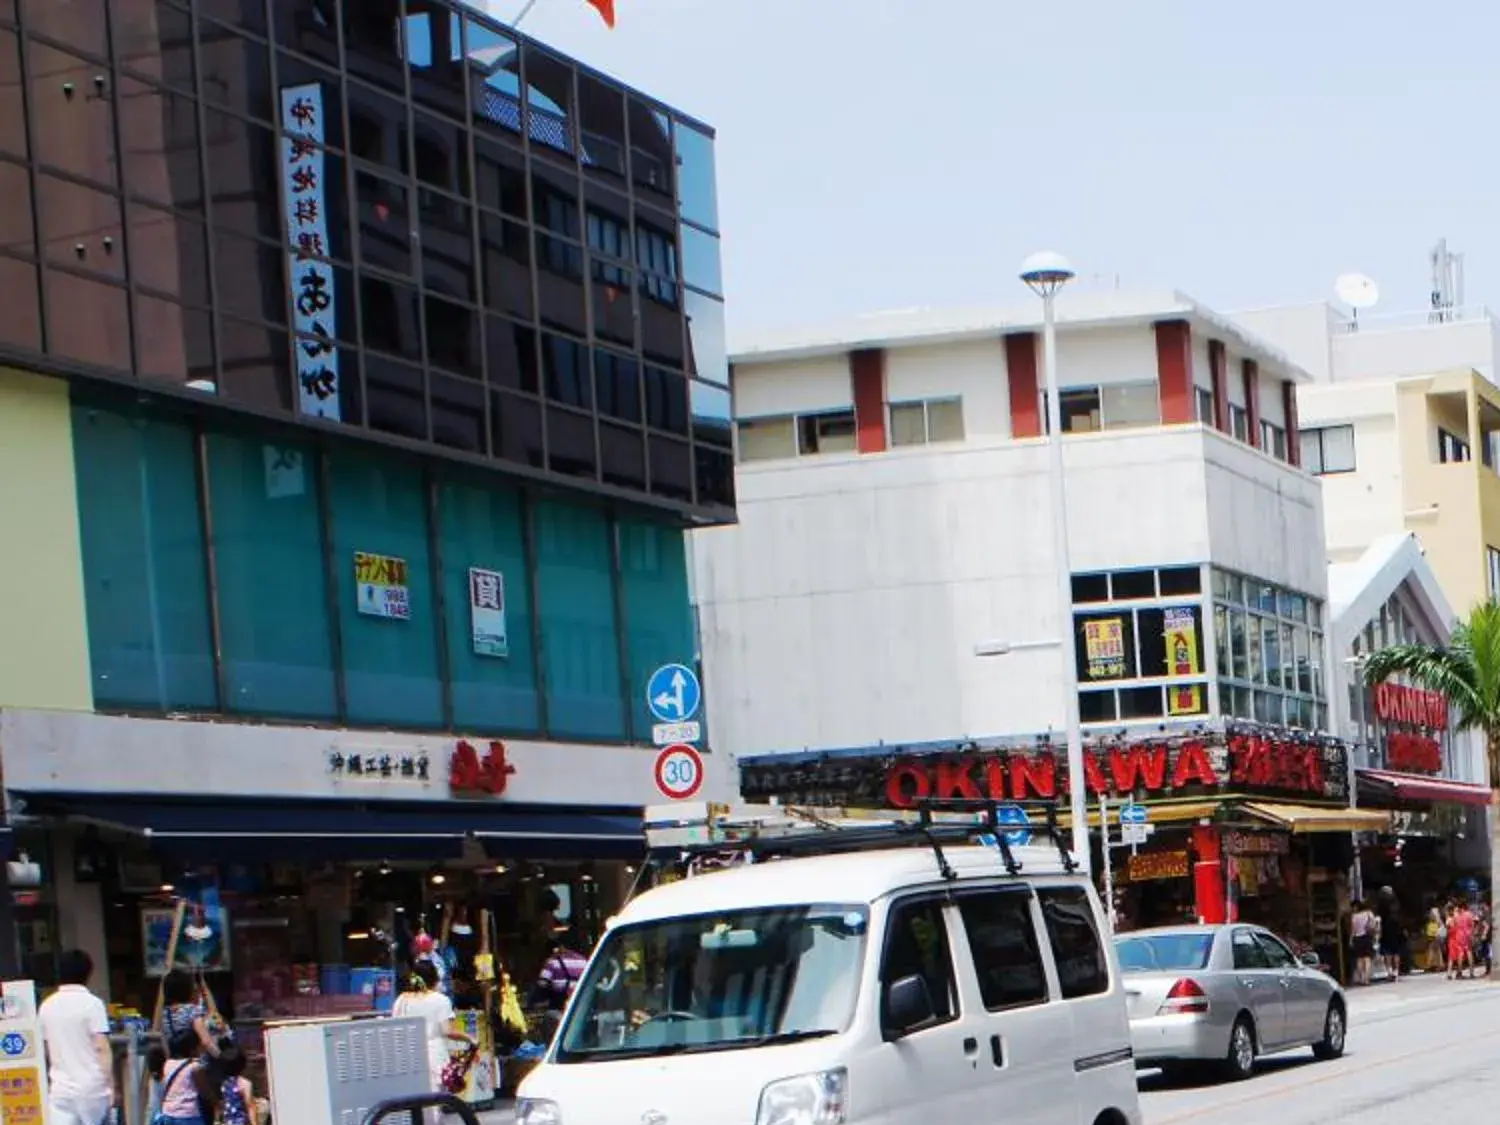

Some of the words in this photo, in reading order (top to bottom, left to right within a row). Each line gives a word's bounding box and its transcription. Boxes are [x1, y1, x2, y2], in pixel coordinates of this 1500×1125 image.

[665, 760, 692, 785] 30
[884, 740, 1217, 808] OKINAWA
[4, 1034, 22, 1053] 39
